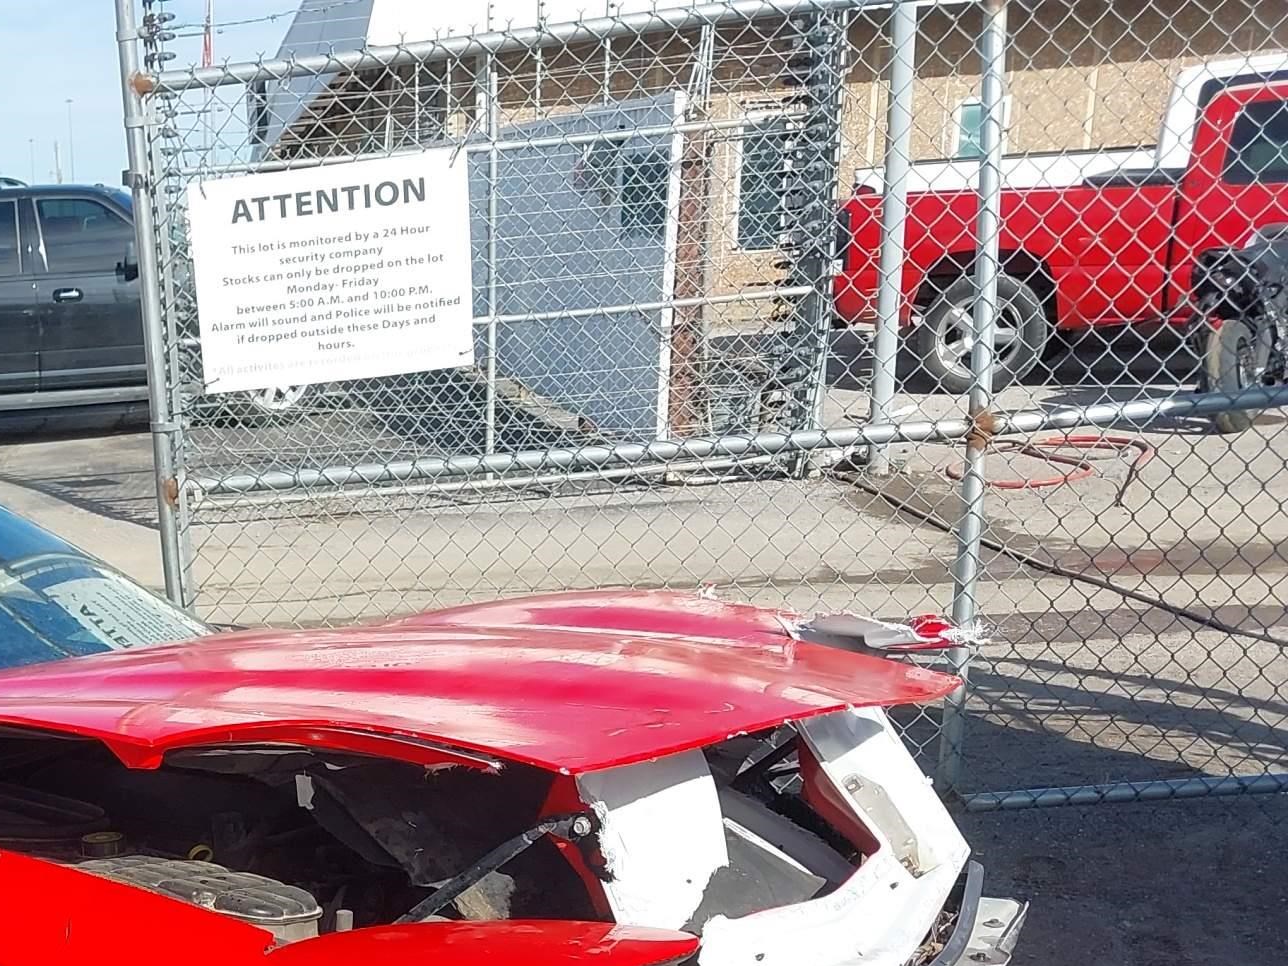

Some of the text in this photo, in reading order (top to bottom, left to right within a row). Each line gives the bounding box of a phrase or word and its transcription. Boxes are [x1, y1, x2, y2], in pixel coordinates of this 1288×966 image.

[231, 177, 426, 224] ATTENTION
[231, 244, 256, 255] This
[259, 242, 274, 252] lot
[277, 242, 286, 250] is
[289, 232, 352, 249] monitored
[355, 232, 370, 242] by
[383, 228, 397, 238] 24
[400, 225, 431, 235] Hour
[222, 253, 444, 287] Stocks can only be dropped on the lot
[279, 246, 383, 265] security company
[341, 276, 379, 288] Friday
[211, 296, 461, 332] Alarm will sound and Police will be notified
[236, 285, 433, 315] between 5:00 A.M. and 10:00 P.M.
[237, 314, 436, 344] if dropped outside these Days and
[318, 341, 355, 350] hours.
